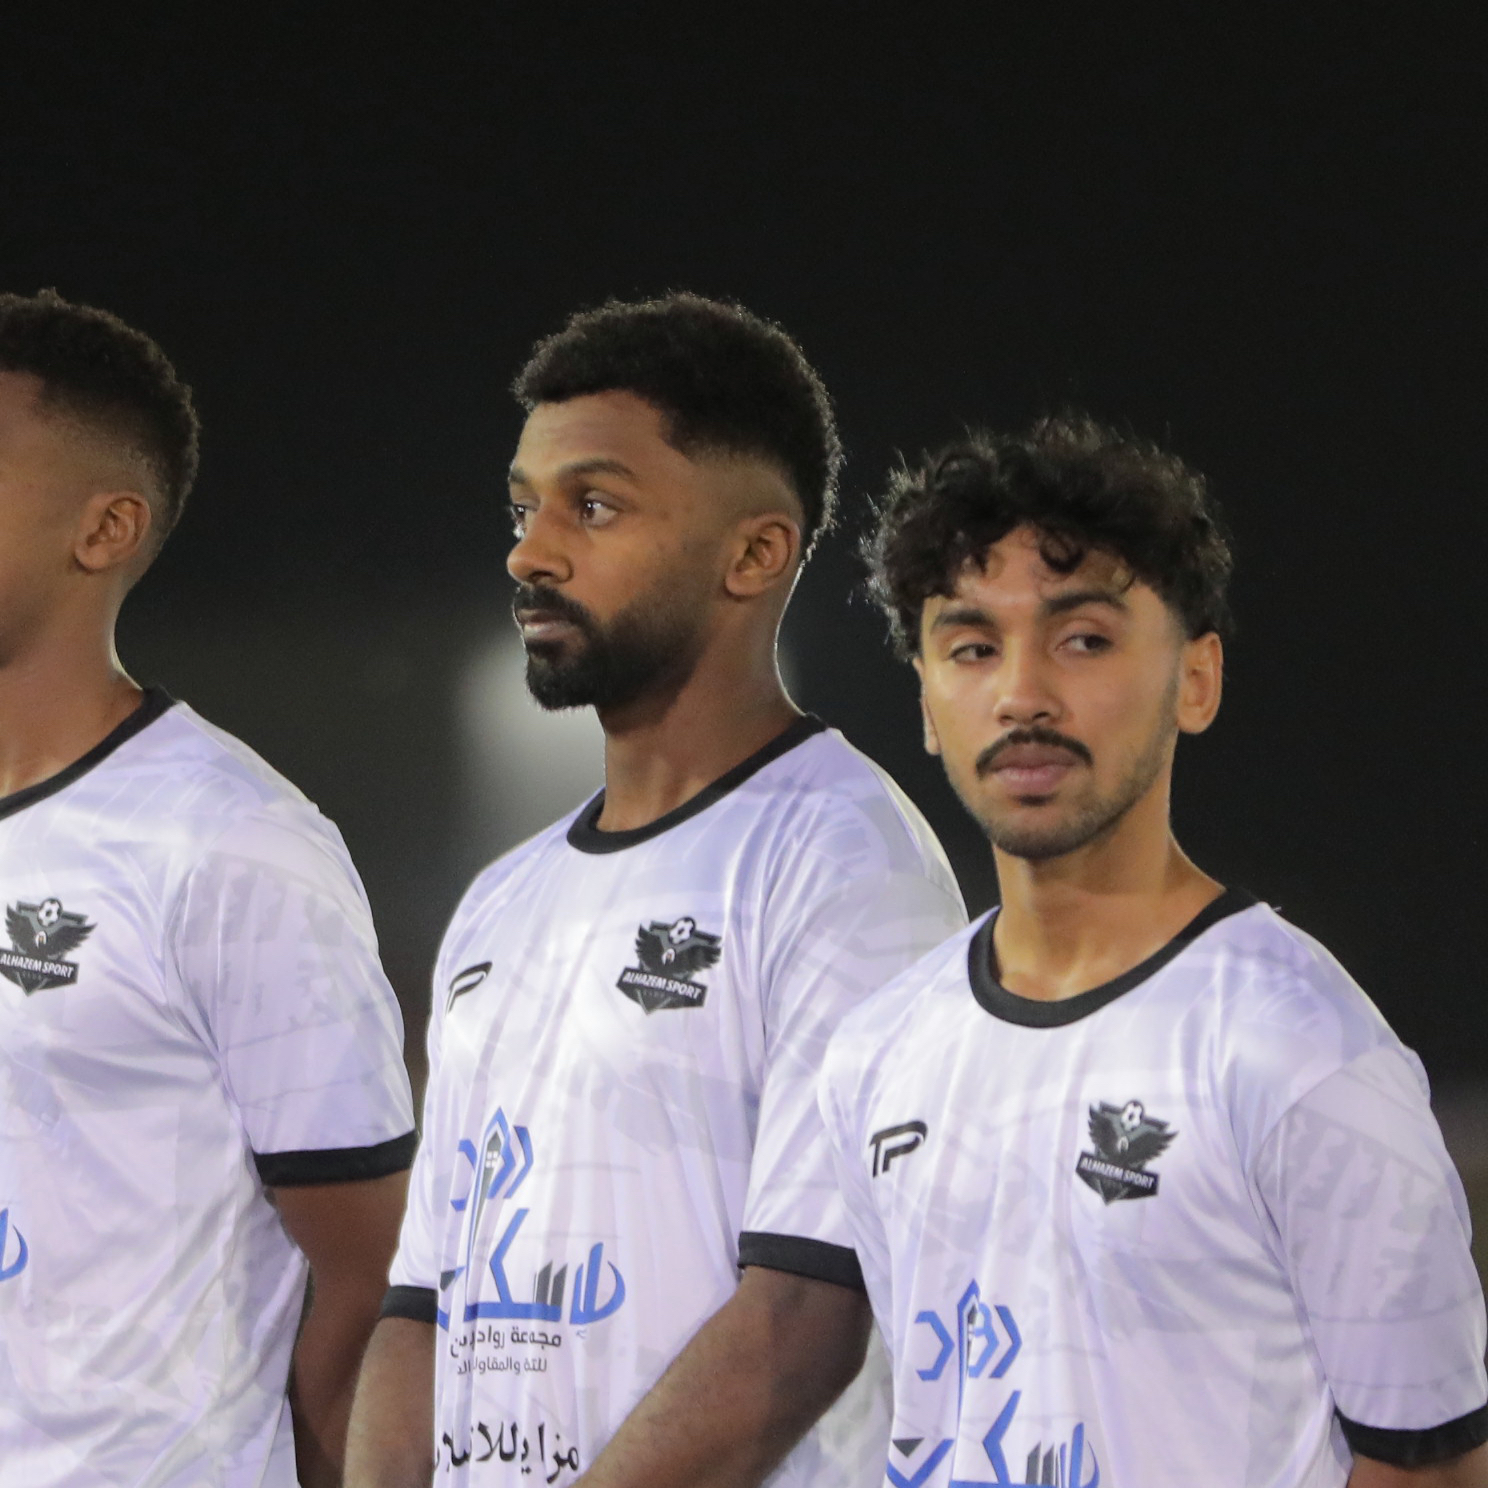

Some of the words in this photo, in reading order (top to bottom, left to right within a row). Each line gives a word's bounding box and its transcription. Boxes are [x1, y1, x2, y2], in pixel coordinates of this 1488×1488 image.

[0, 953, 43, 972] ALHAZEM
[42, 961, 74, 978] SPORT
[622, 971, 667, 990] ALHAZEM
[666, 980, 702, 1000] SPORT
[1079, 1157, 1124, 1181] ALHAZEM
[1123, 1169, 1154, 1189] SPORT
